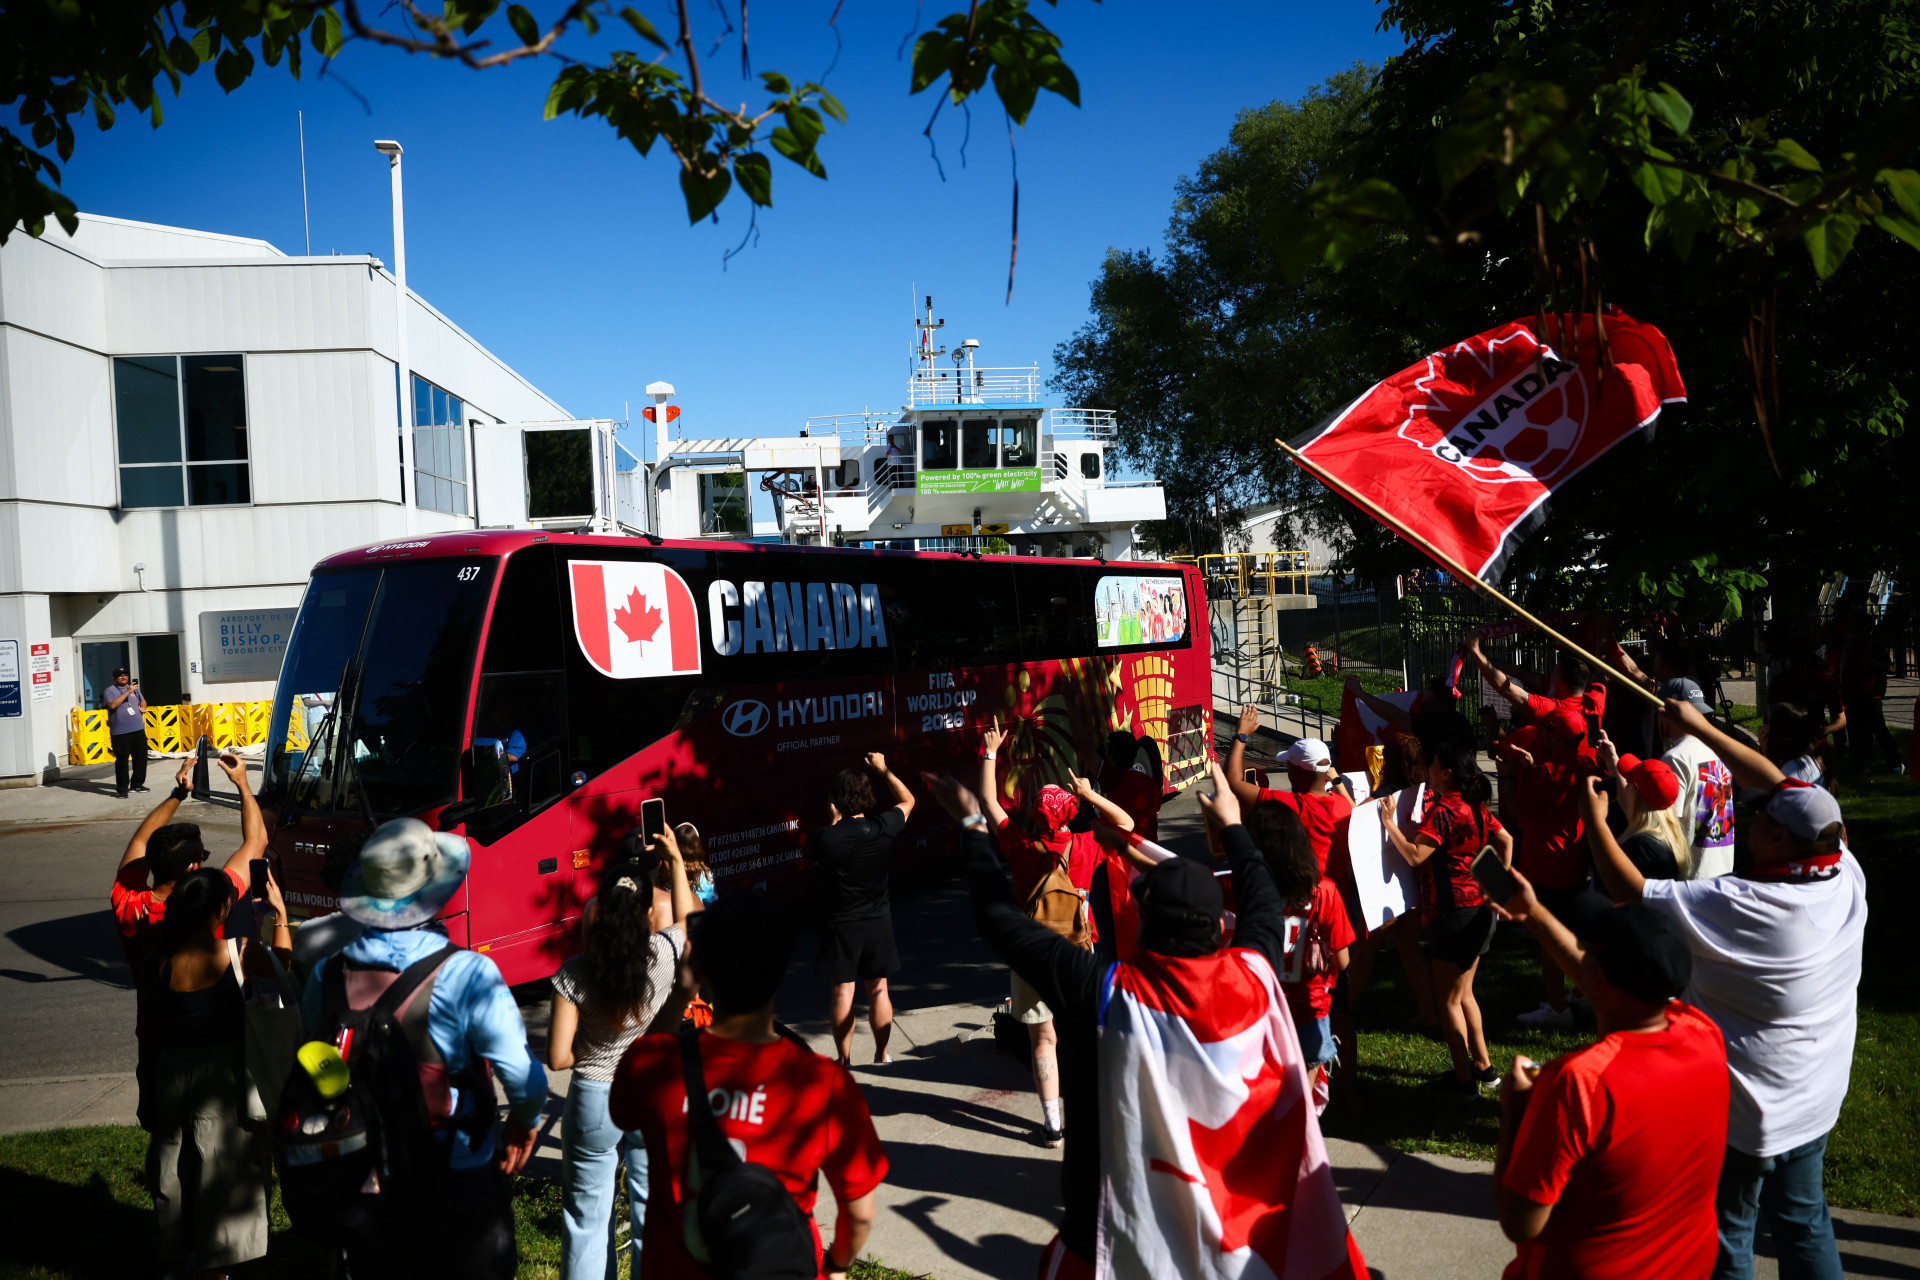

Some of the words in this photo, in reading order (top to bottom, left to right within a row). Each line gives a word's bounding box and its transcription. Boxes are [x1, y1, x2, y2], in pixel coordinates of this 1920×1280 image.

[1437, 357, 1574, 463] CANADA
[952, 473, 960, 481] by
[962, 472, 981, 480] 100%
[982, 472, 1002, 480] green
[1003, 470, 1038, 478] electricity
[457, 566, 480, 581] 437
[221, 614, 265, 622] AÉROPORT
[707, 579, 888, 657] CANADA
[221, 623, 262, 635] BILLY
[222, 634, 280, 646] BISHOP
[222, 646, 265, 655] TORONTO
[928, 672, 955, 689] FIFA
[777, 691, 883, 728] HYUNDAI
[907, 694, 951, 713] WORLD
[953, 690, 977, 708] CUP
[922, 711, 965, 732] 2026
[776, 738, 809, 752] OFFICIAL
[810, 735, 841, 748] PARTNER
[708, 837, 716, 848] PT
[766, 821, 789, 835] CANADA
[789, 819, 799, 830] INC
[294, 841, 330, 855] PRE
[709, 852, 719, 863] US
[719, 849, 731, 861] DOT
[712, 864, 735, 878] EATING
[284, 890, 303, 904] FIFA
[302, 893, 334, 908] WORLD
[683, 1084, 767, 1125] ONÉ
